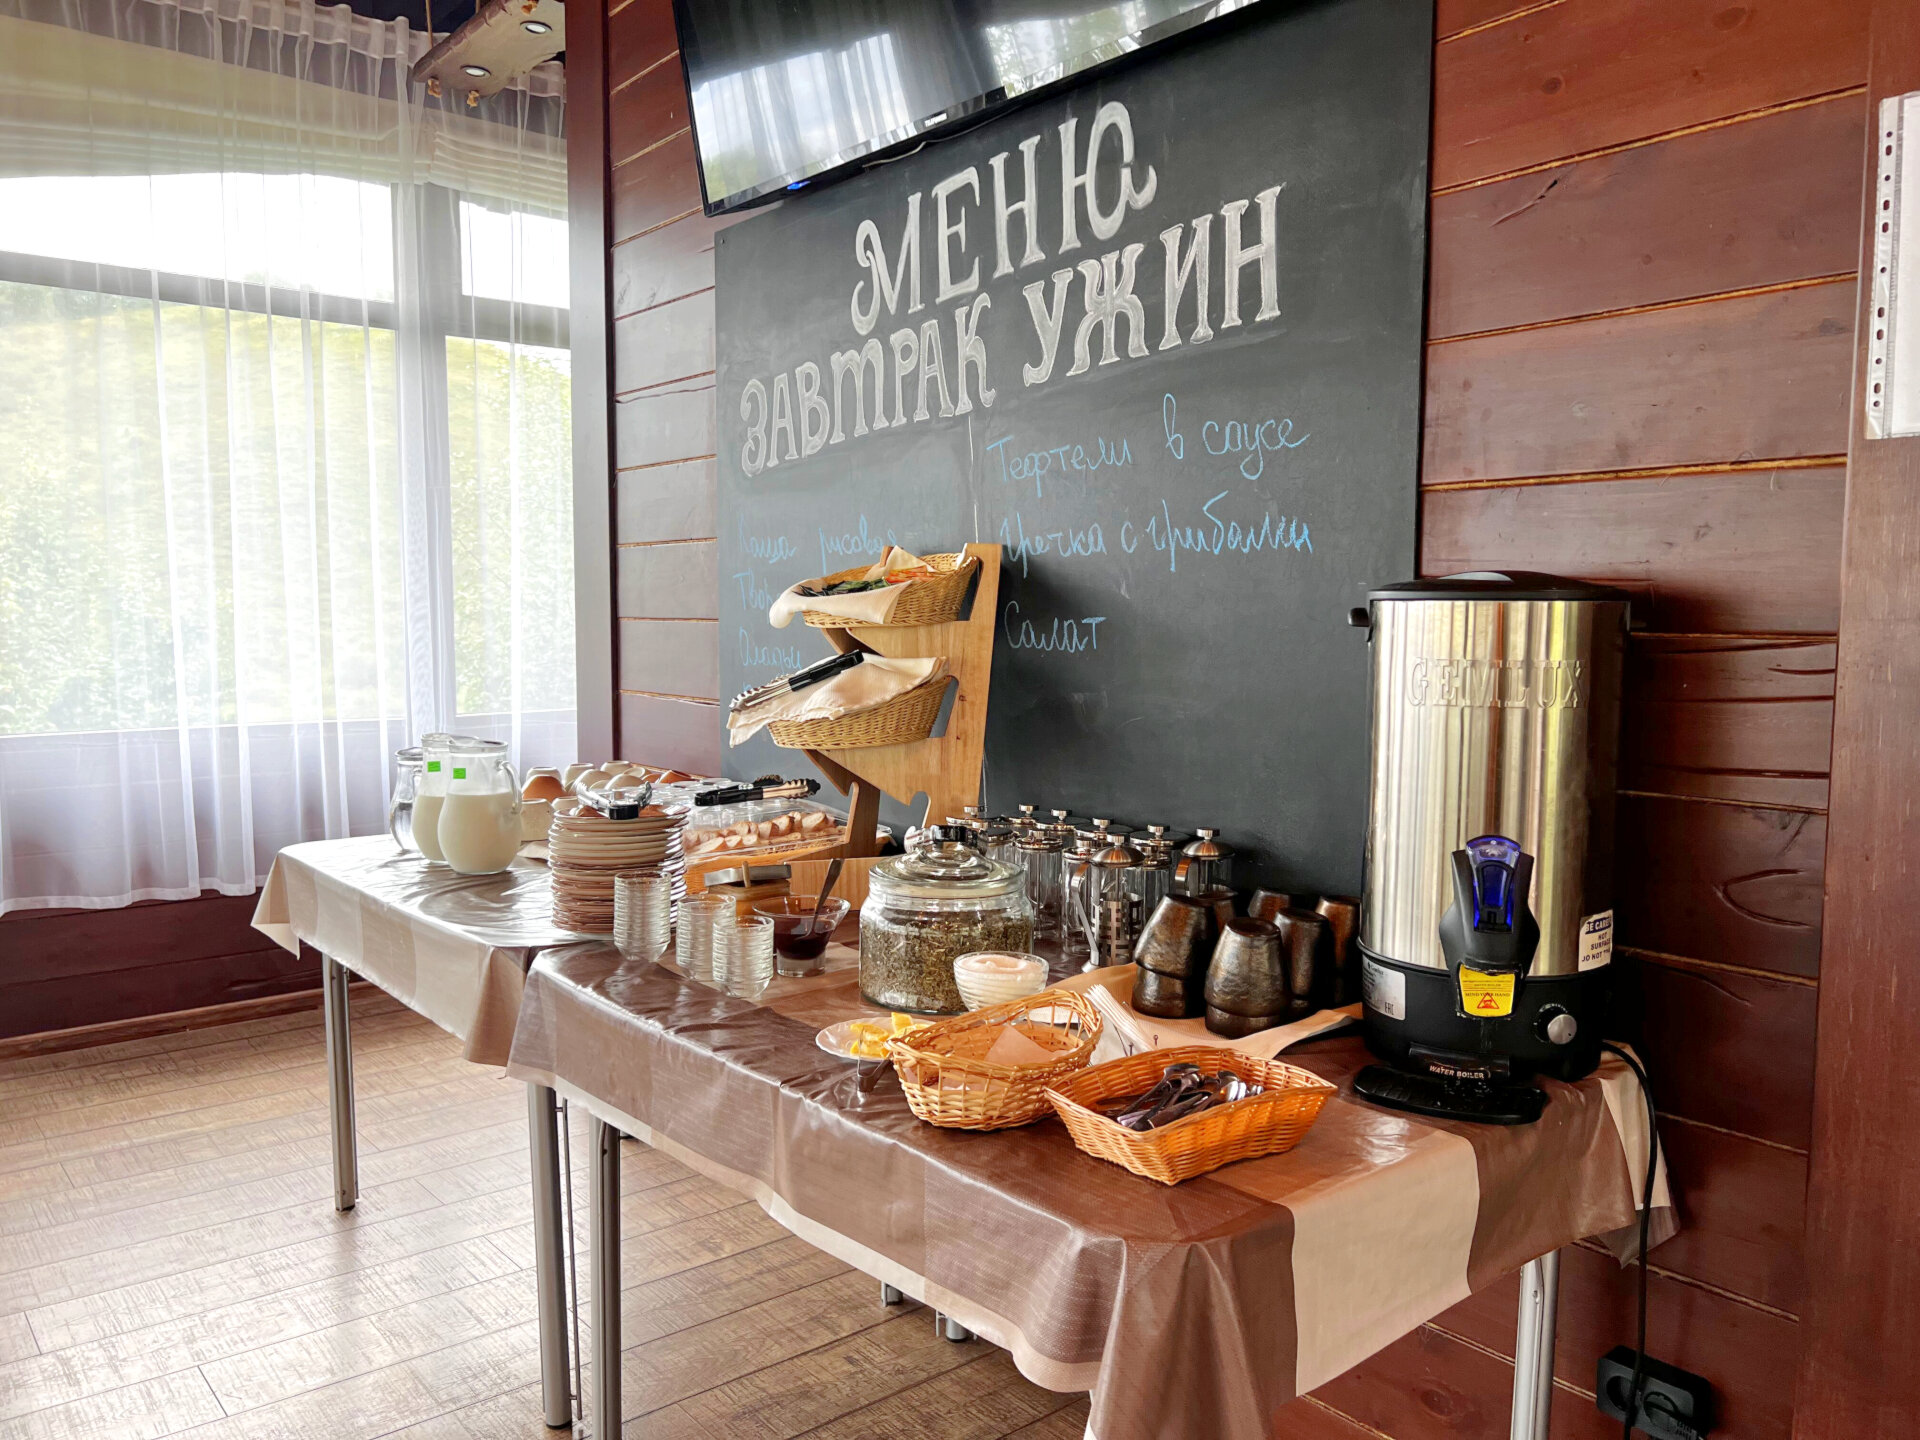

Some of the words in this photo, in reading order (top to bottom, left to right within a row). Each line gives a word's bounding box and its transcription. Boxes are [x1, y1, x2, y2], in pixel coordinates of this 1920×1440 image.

[850, 100, 1157, 336] МЕНЮ
[740, 293, 997, 478] ЗАВТРАК
[1022, 182, 1288, 388] УЖИН
[986, 434, 1134, 498] Тефтели
[1162, 392, 1184, 460] в
[1202, 418, 1312, 481] соусе
[1003, 600, 1107, 654] Салат
[1406, 656, 1587, 709] GEMLUX
[1429, 1065, 1455, 1077] WATER
[1456, 1070, 1485, 1080] BOILER
